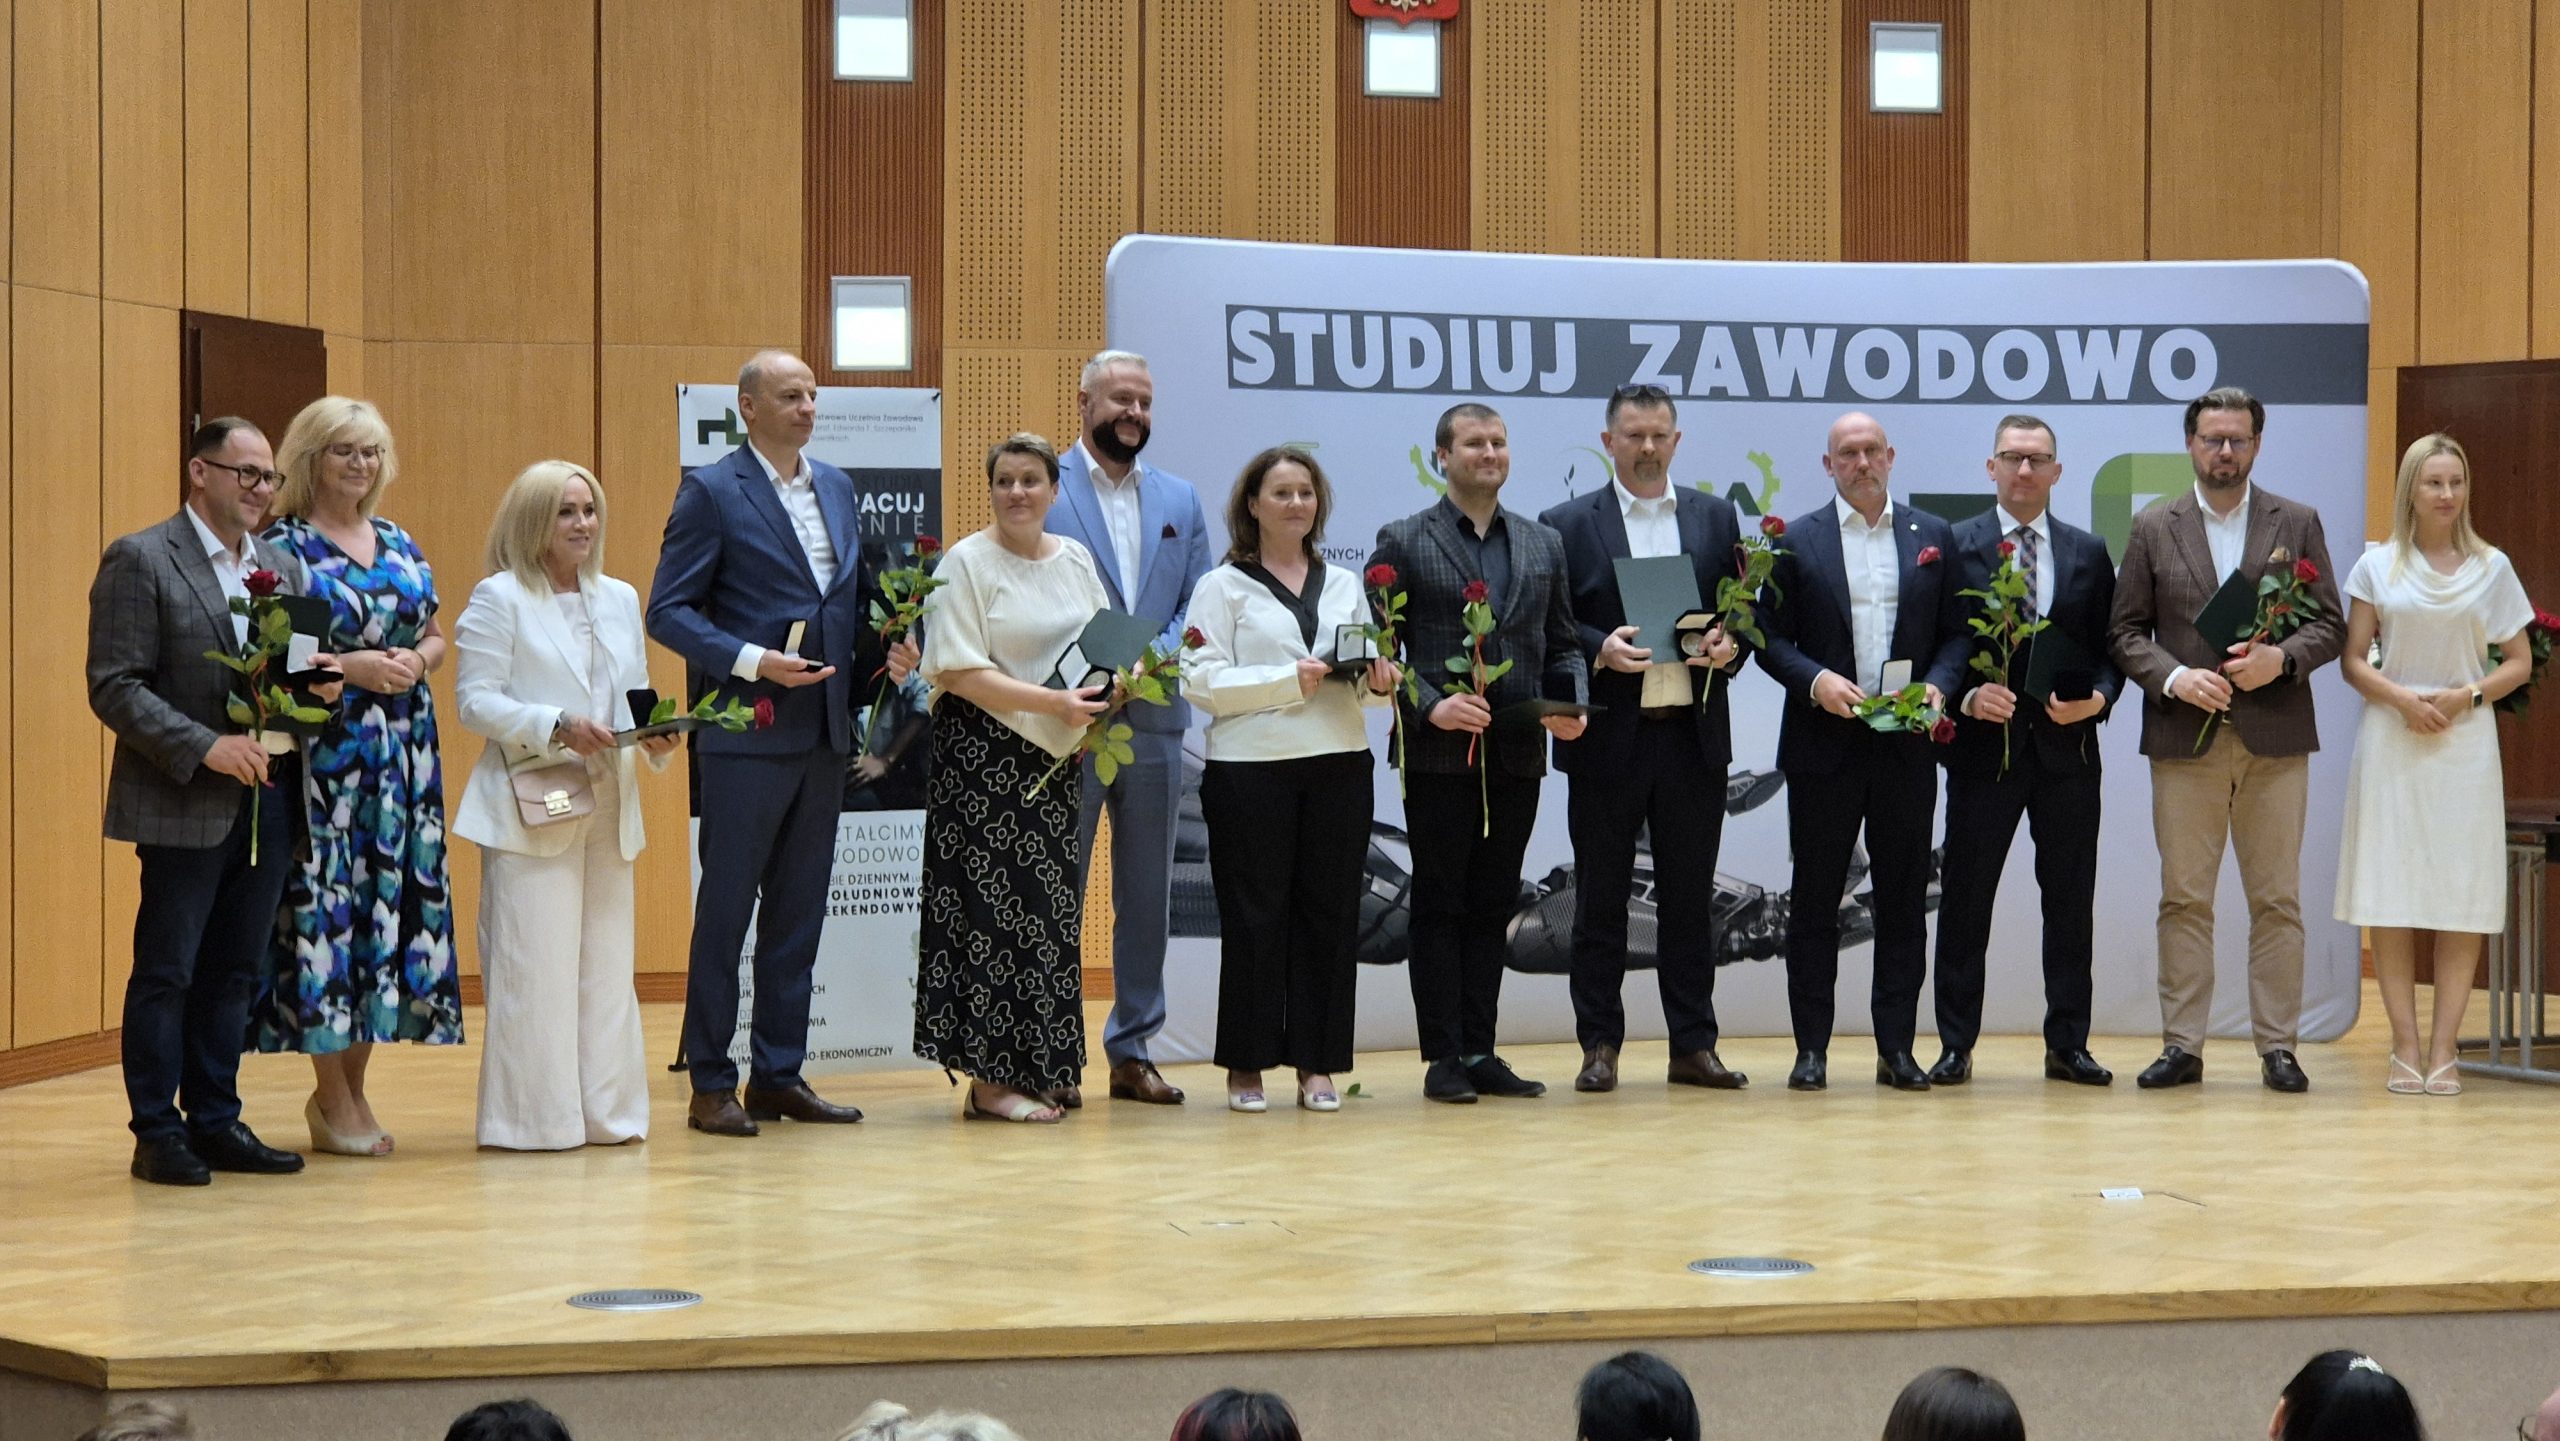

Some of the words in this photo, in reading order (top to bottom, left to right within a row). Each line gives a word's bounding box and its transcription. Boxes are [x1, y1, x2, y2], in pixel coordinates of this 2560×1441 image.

[1231, 308, 1577, 394] STUDIUJ
[1629, 322, 2218, 401] ZAWODOWO
[848, 873, 910, 886] DZIENNYM
